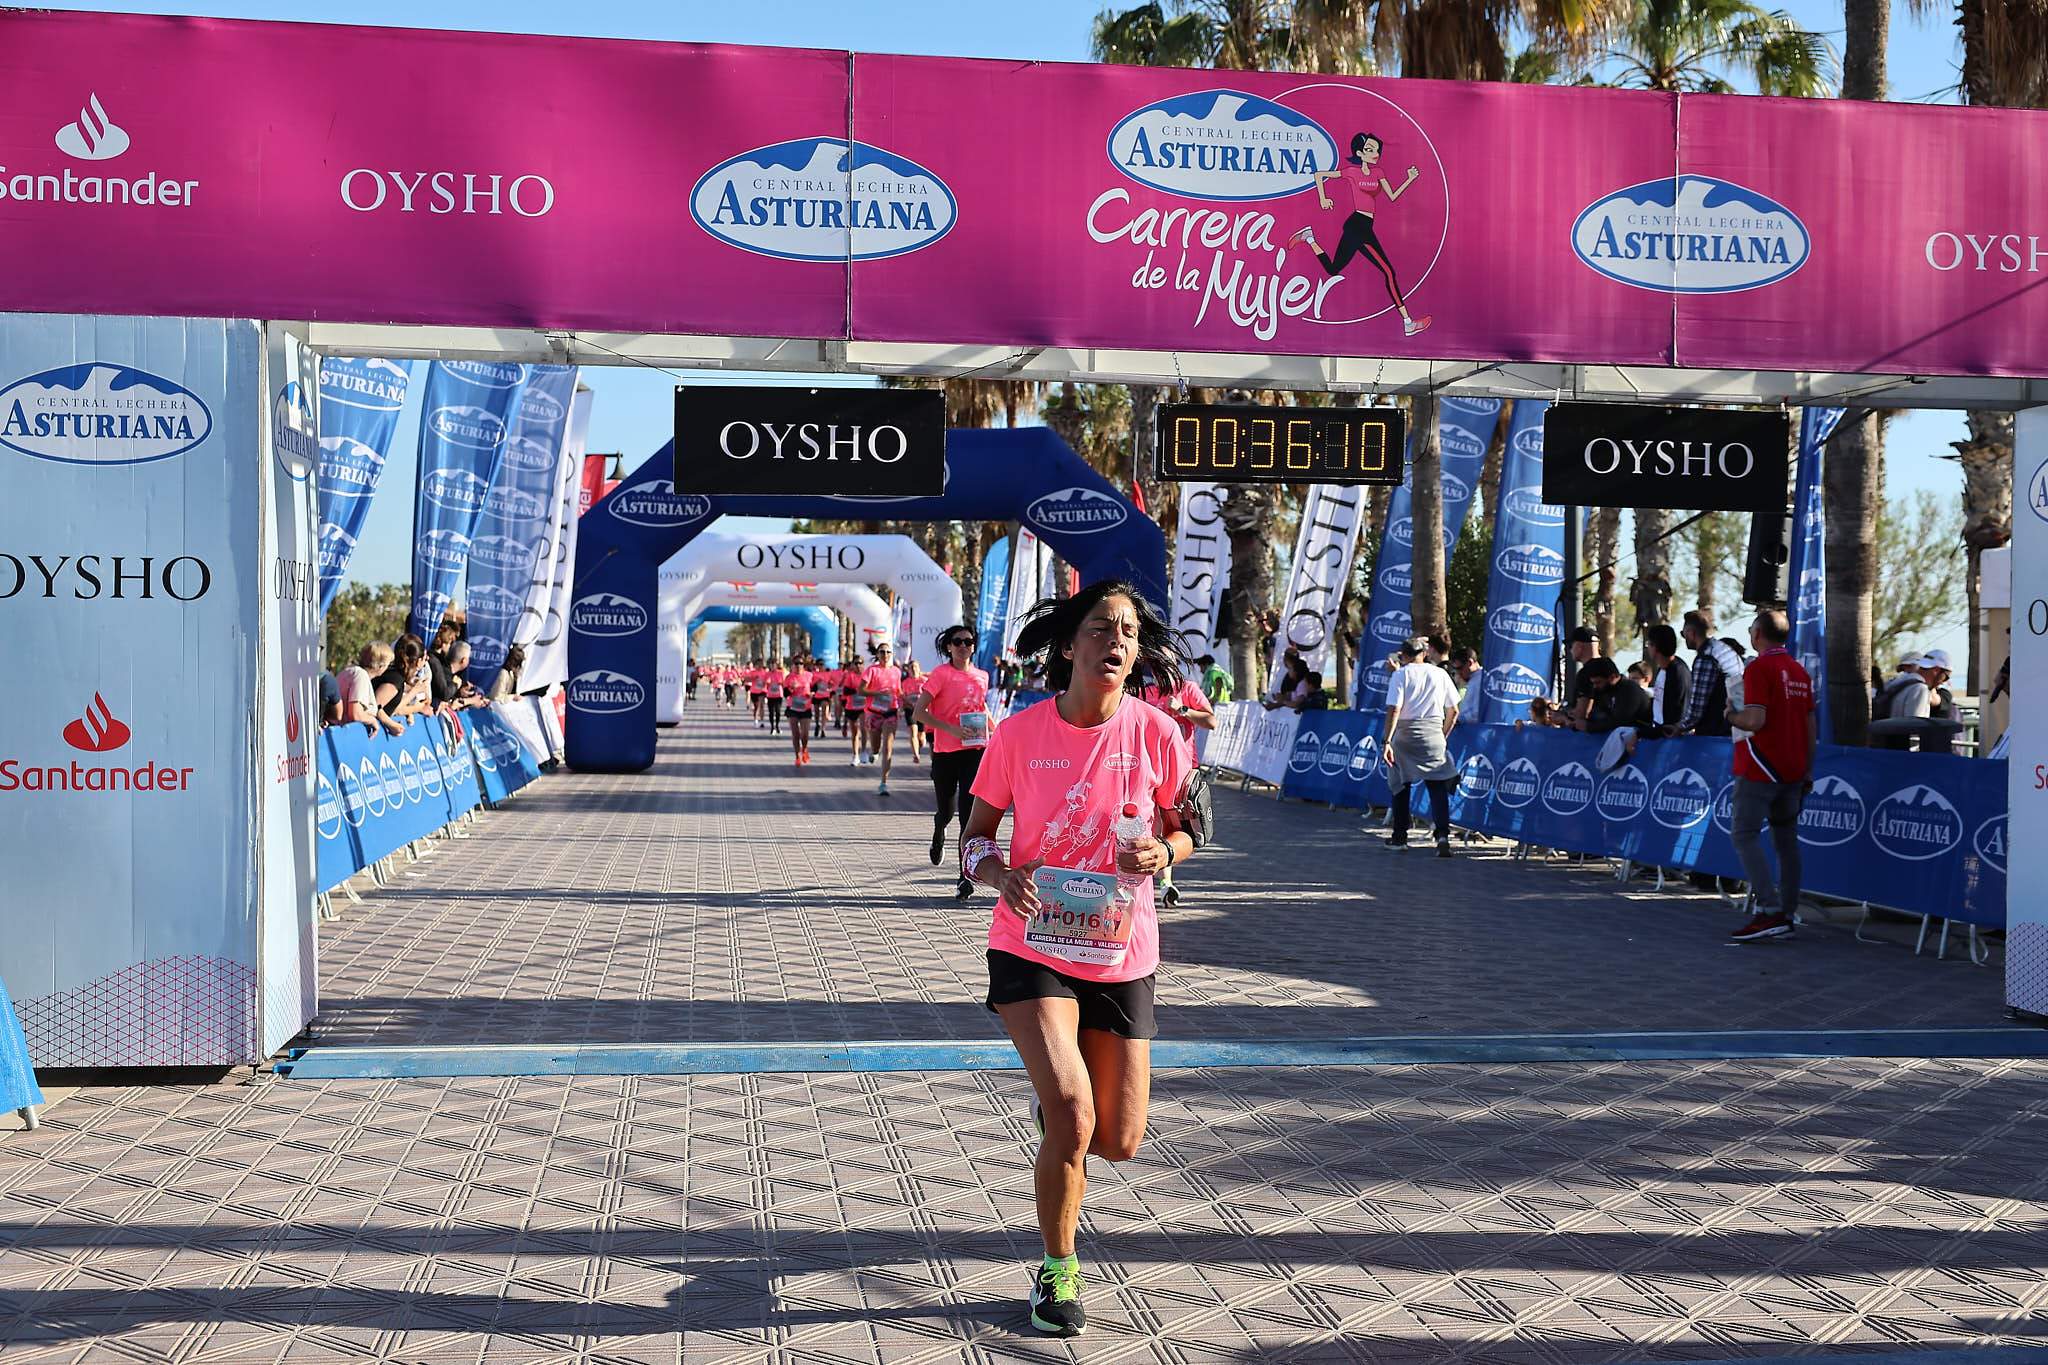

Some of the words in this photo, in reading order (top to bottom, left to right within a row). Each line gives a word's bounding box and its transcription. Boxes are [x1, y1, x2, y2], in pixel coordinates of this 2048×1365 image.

[1162, 125, 1233, 139] CENTRAL
[1241, 129, 1314, 142] LECHERA
[1125, 126, 1319, 175] ASTURIANA
[339, 168, 556, 218] OYSHO
[753, 177, 836, 192] CENTRAL
[711, 180, 937, 231] ASTURIANA
[1086, 187, 1275, 252] Carrera
[1627, 214, 1701, 227] CENTRAL
[1709, 216, 1785, 230] LECHERA
[1590, 214, 1792, 265] ASTURIANA
[1131, 250, 1168, 290] de
[1174, 248, 1200, 291] la
[1194, 247, 1345, 341] Mujer
[37, 397, 109, 408] CENTRAL
[116, 399, 188, 410] LECHERA
[1, 398, 195, 440] ASTURIANA
[720, 421, 908, 463] OYSHO
[1175, 417, 1386, 471] 00:36:10
[1584, 437, 1755, 479] OYSHO
[615, 497, 702, 516] ASTURIANA
[1036, 506, 1121, 523] ASTURIANA
[737, 543, 865, 570] OYSHO
[1287, 486, 1356, 652] OYSH
[1501, 553, 1564, 577] ASTURIANA
[573, 608, 642, 627] ASTURIANA
[571, 684, 639, 703] ASTURIANA
[0, 760, 194, 791] Santander
[1029, 759, 1070, 769] OYSHO
[1653, 788, 1704, 815] ASTURIANA
[1797, 808, 1857, 831] STURIANA
[1875, 808, 1950, 845] ASTURIANA
